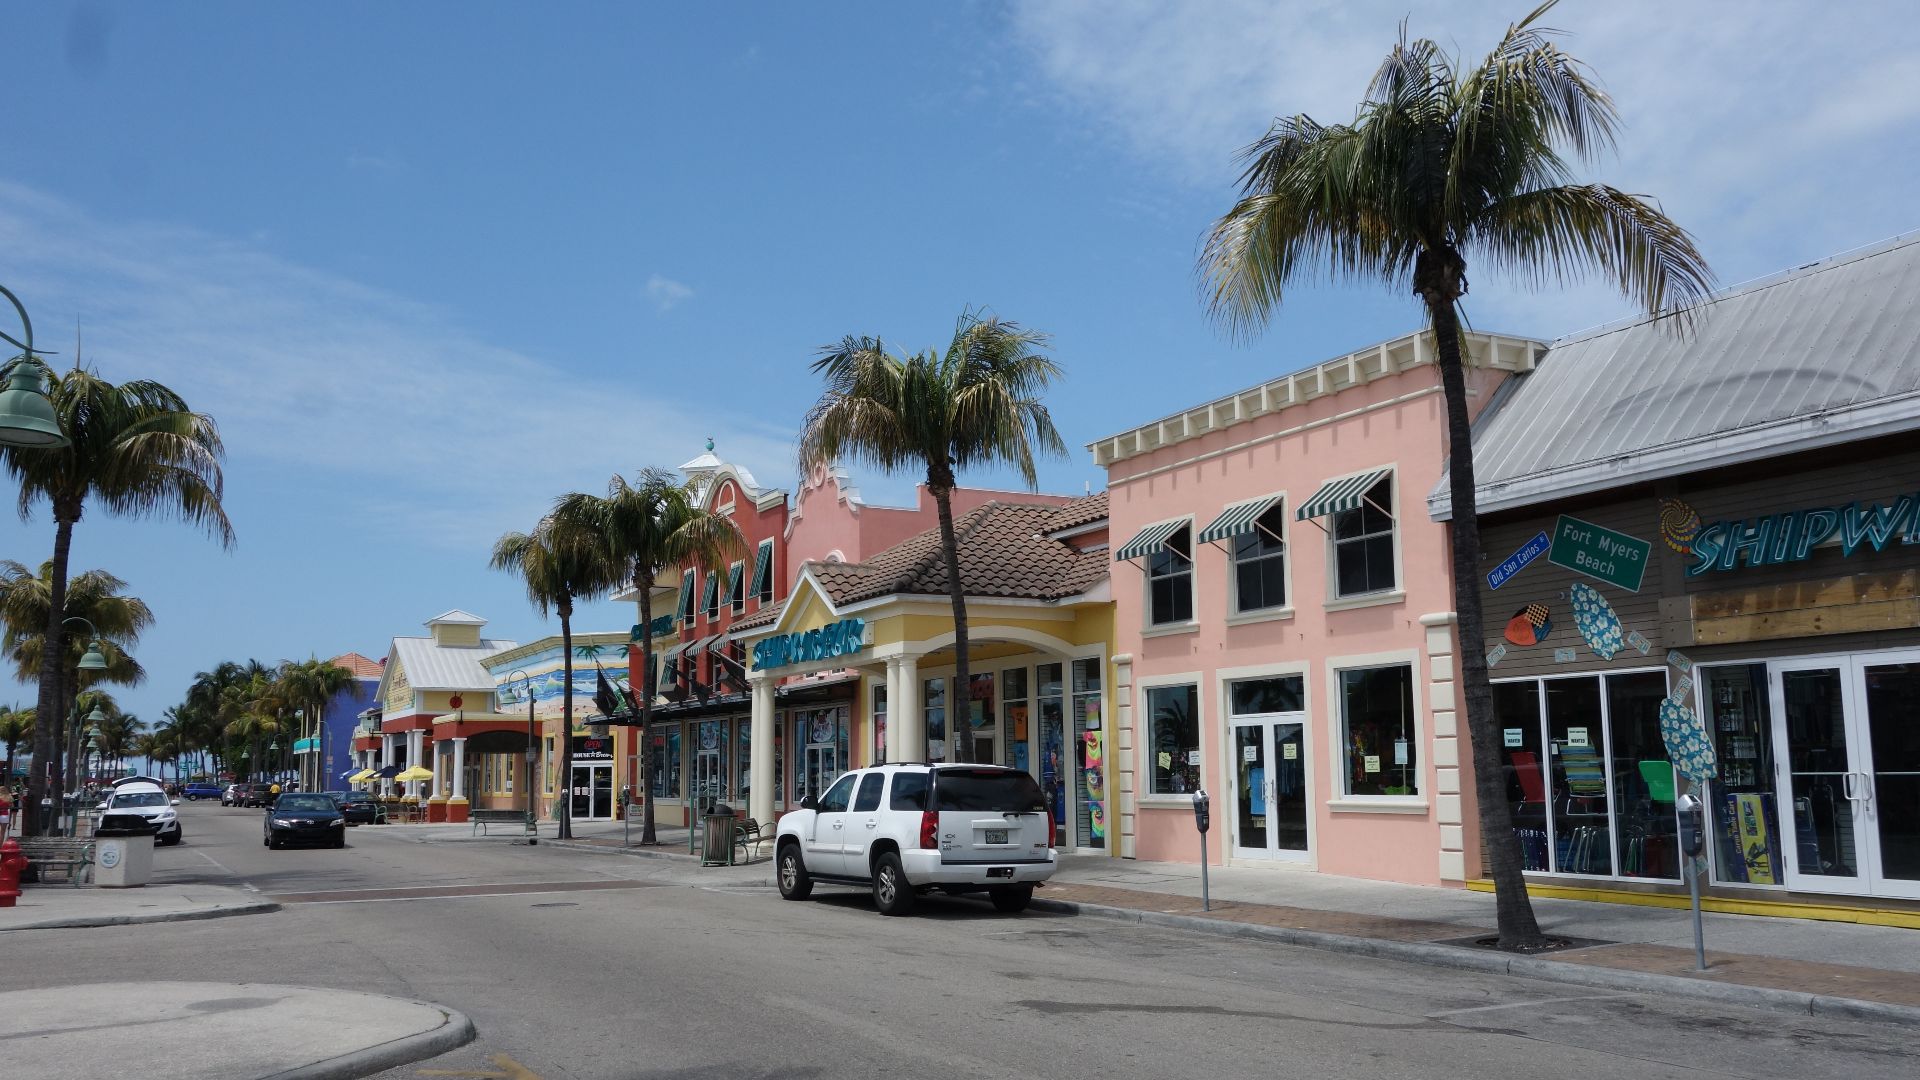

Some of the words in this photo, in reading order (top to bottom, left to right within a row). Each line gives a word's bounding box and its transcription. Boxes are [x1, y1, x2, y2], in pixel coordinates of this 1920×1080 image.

[1563, 524, 1593, 545] Fort
[1598, 535, 1640, 561] Myers
[1491, 569, 1503, 585] Old
[1503, 560, 1518, 575] San
[1517, 543, 1540, 565] Carlos
[1575, 549, 1616, 576] Beach
[584, 740, 602, 748] OPEN
